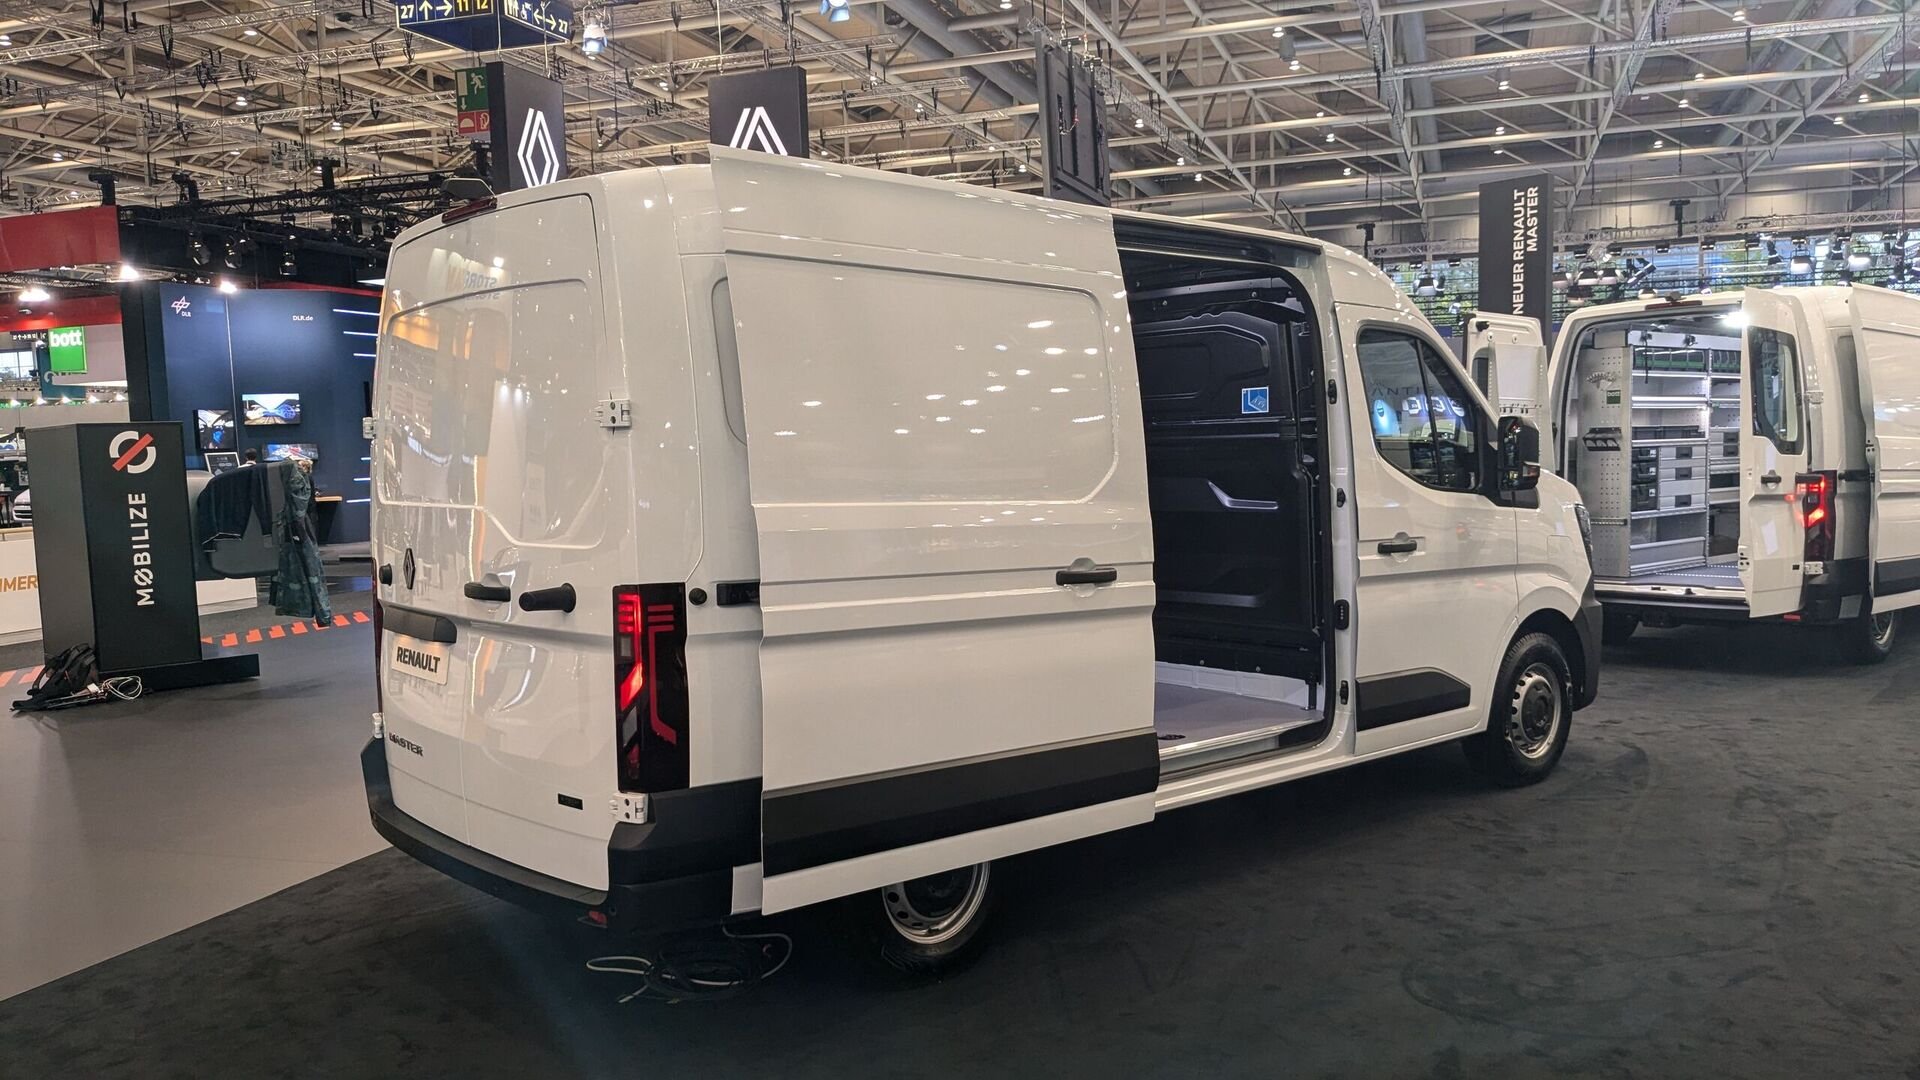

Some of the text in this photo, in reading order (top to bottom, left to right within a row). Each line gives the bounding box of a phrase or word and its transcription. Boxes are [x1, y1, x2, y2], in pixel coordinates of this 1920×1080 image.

[400, 4, 415, 19] 27
[456, 0, 469, 12] 11
[557, 19, 568, 34] 27
[1526, 186, 1539, 252] MASTER
[1512, 189, 1525, 315] NEUER RENAULT
[49, 330, 83, 348] bott
[396, 646, 441, 674] RENAULT
[388, 732, 424, 757] MASTER
